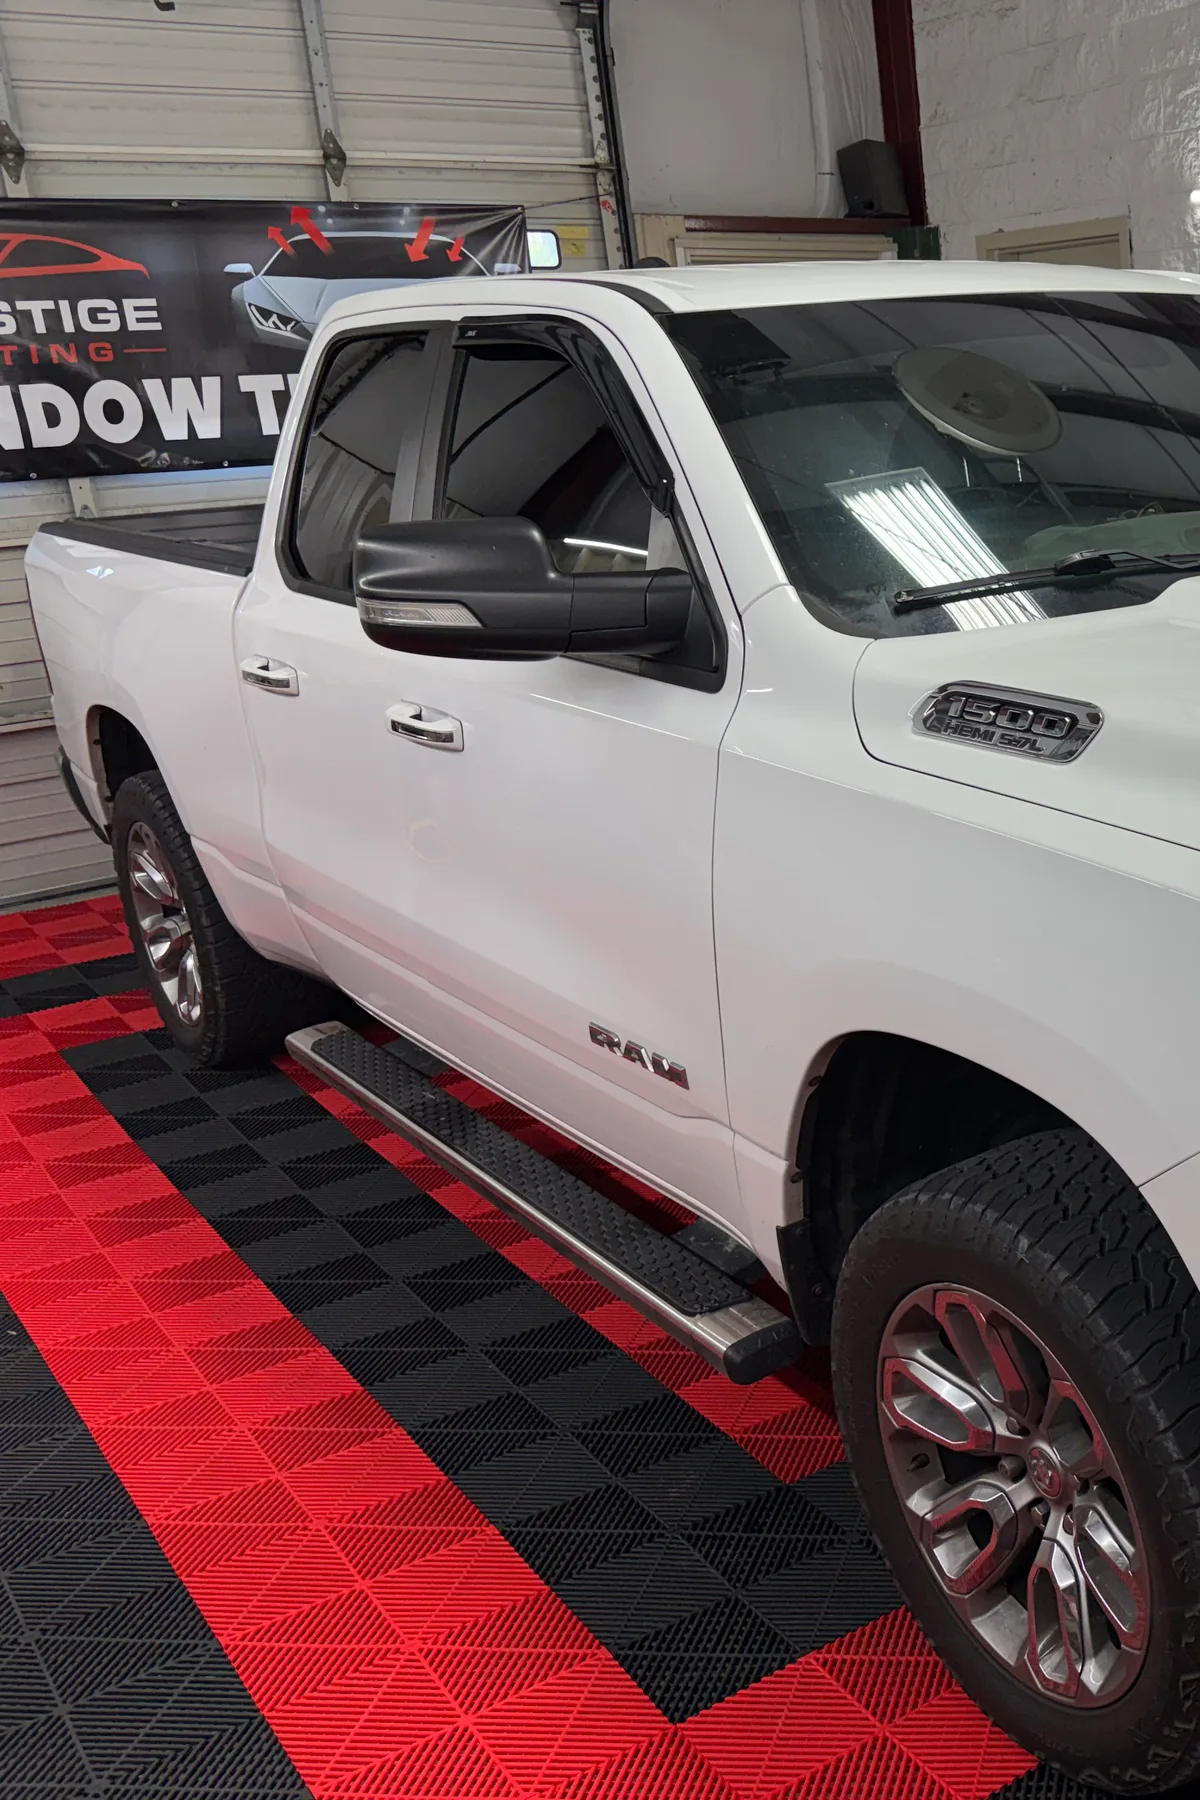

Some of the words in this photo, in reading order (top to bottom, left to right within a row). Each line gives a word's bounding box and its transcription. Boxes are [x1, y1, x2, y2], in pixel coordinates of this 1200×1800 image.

[0, 342, 114, 366] TING
[942, 718, 997, 744] HEMI
[948, 696, 1072, 738] 1500
[588, 1021, 690, 1091] RAM
